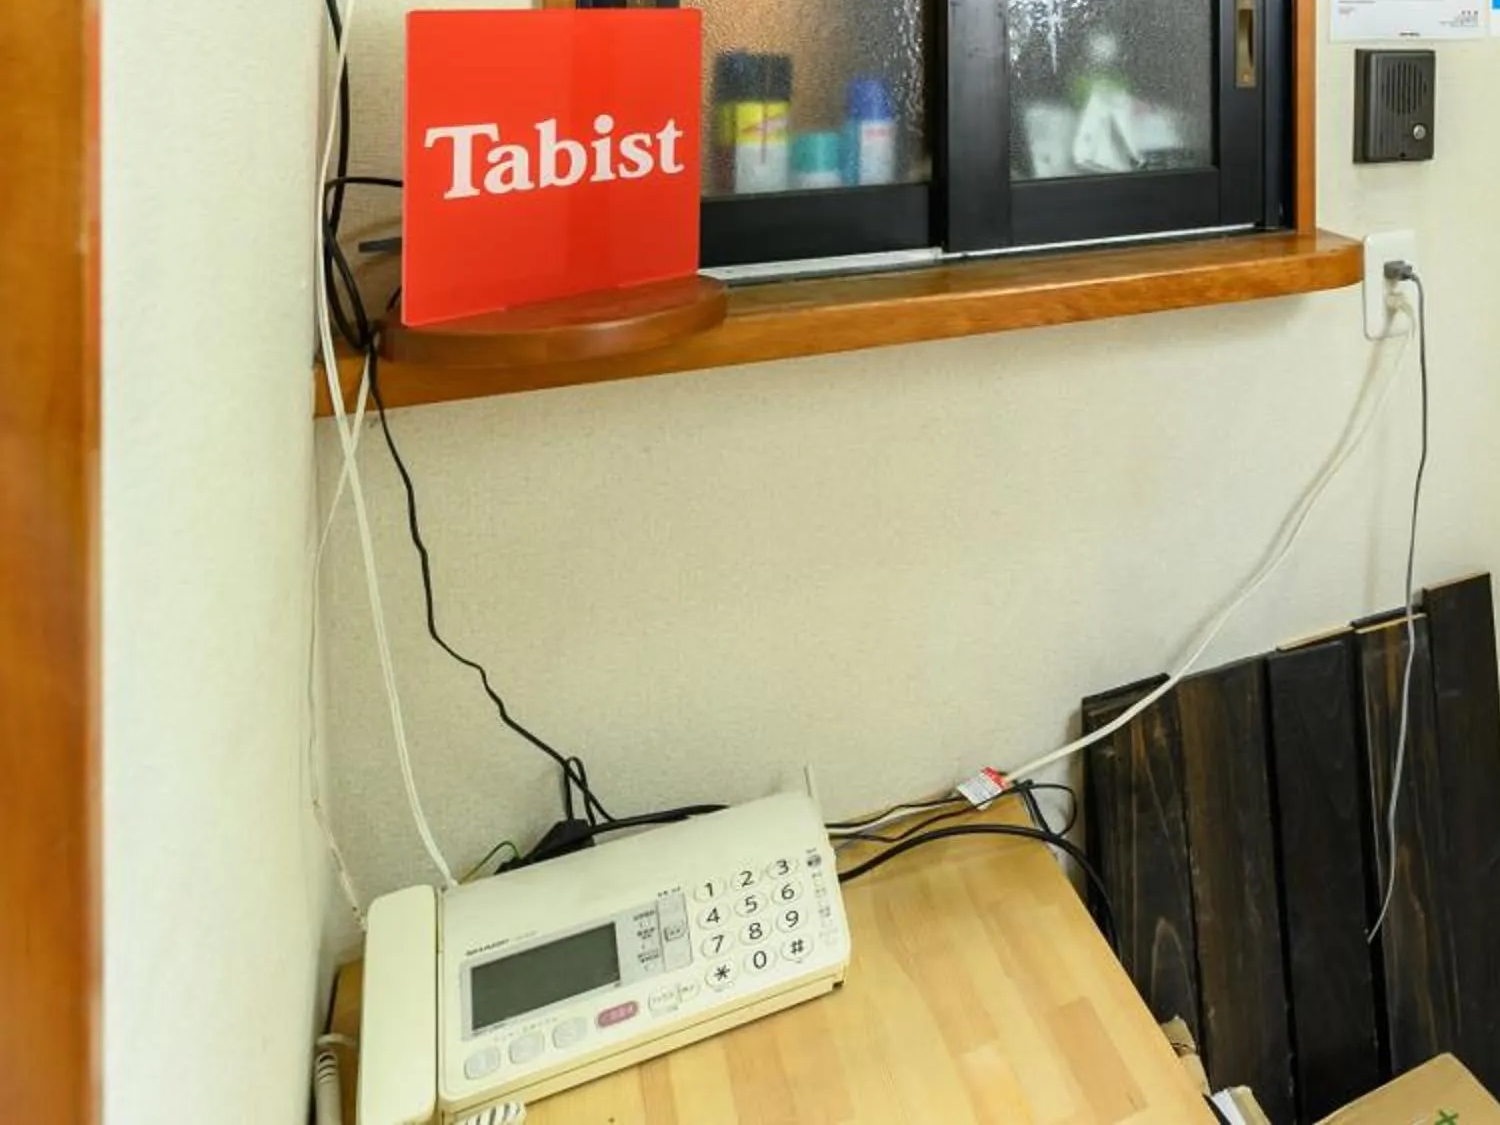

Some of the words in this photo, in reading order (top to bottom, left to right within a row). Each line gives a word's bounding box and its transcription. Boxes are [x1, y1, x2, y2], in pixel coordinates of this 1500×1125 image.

[424, 114, 684, 200] Tabist
[704, 882, 714, 898] 1
[739, 870, 754, 887] 2
[776, 859, 789, 875] 3
[706, 908, 720, 923] 4
[744, 895, 758, 913] 5
[781, 884, 795, 900] 6
[712, 935, 725, 953] 7
[748, 922, 763, 940] 8
[785, 910, 799, 927] 9
[753, 951, 767, 969] 0
[790, 939, 804, 955] #
